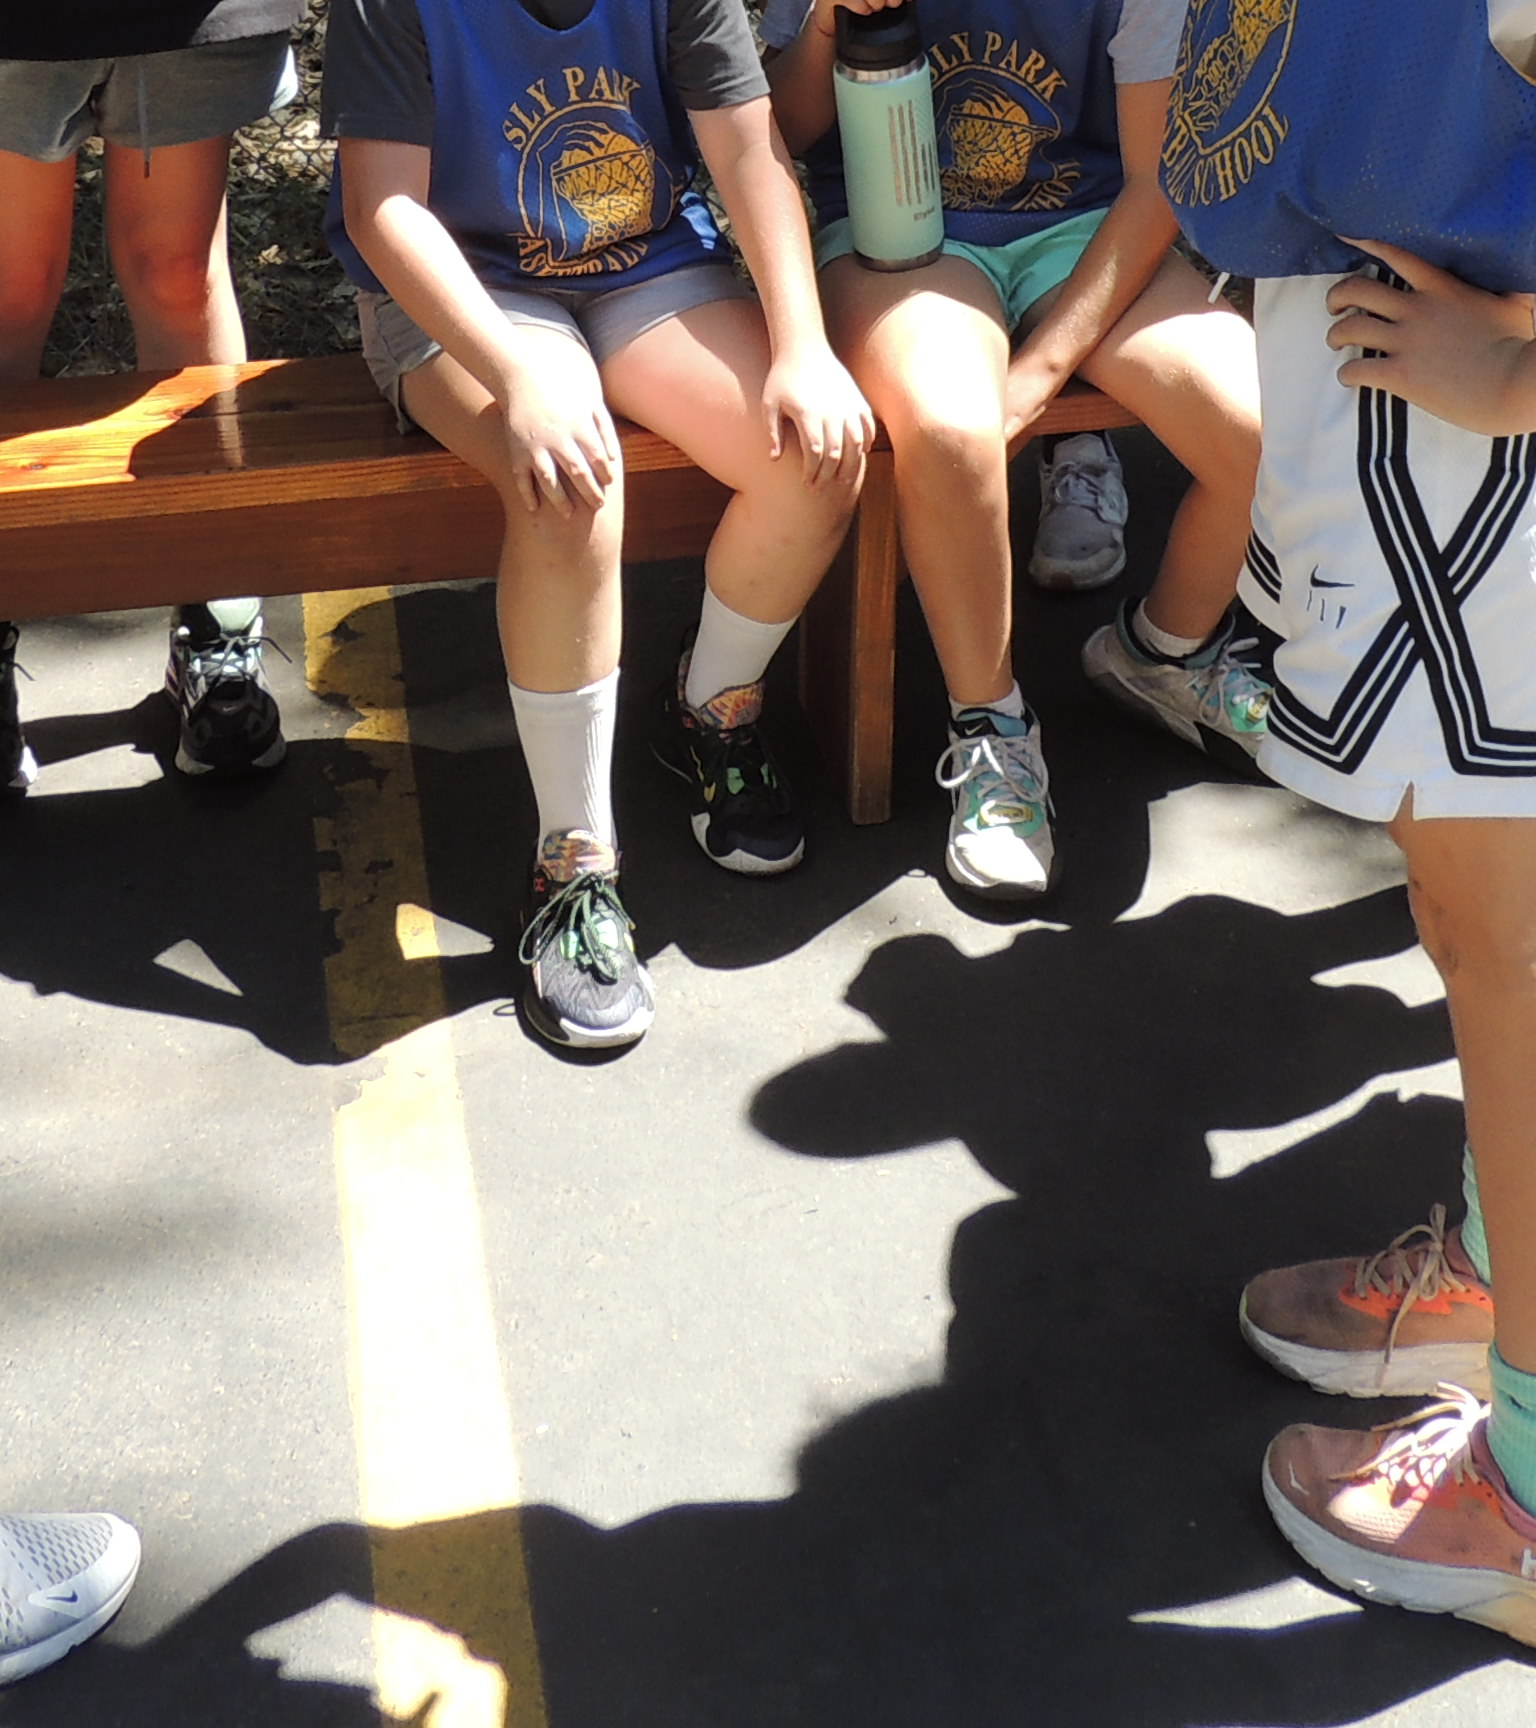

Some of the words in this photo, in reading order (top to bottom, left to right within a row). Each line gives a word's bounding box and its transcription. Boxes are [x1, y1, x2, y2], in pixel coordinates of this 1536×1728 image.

[982, 31, 1068, 103] PARK
[502, 78, 556, 151] SLY
[1190, 102, 1290, 208] SCHOOL
